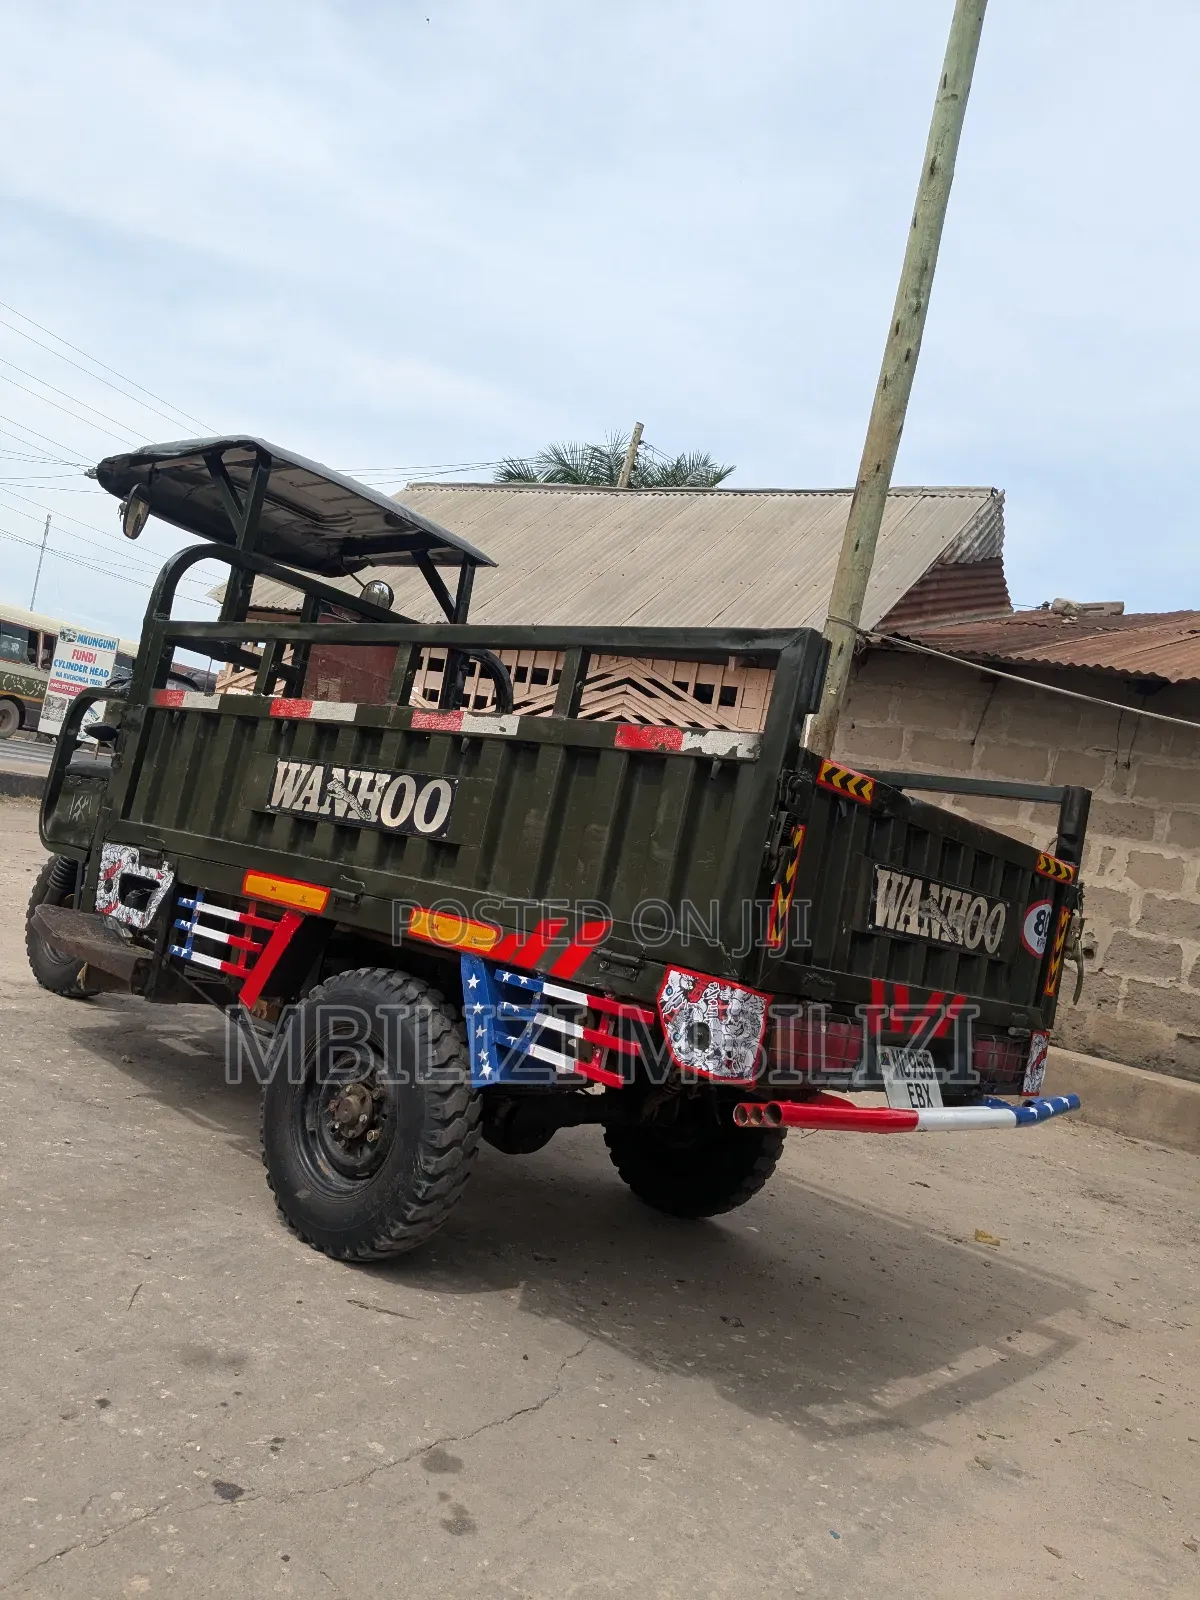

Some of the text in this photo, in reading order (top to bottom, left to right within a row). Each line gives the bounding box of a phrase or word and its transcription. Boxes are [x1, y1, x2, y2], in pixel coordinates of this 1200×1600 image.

[77, 634, 116, 650] MKUNGUNI
[54, 659, 109, 678] CYLINDER HEAD
[270, 761, 452, 833] WANHOO
[875, 869, 1006, 953] WANHOO
[906, 1081, 934, 1108] EBX
